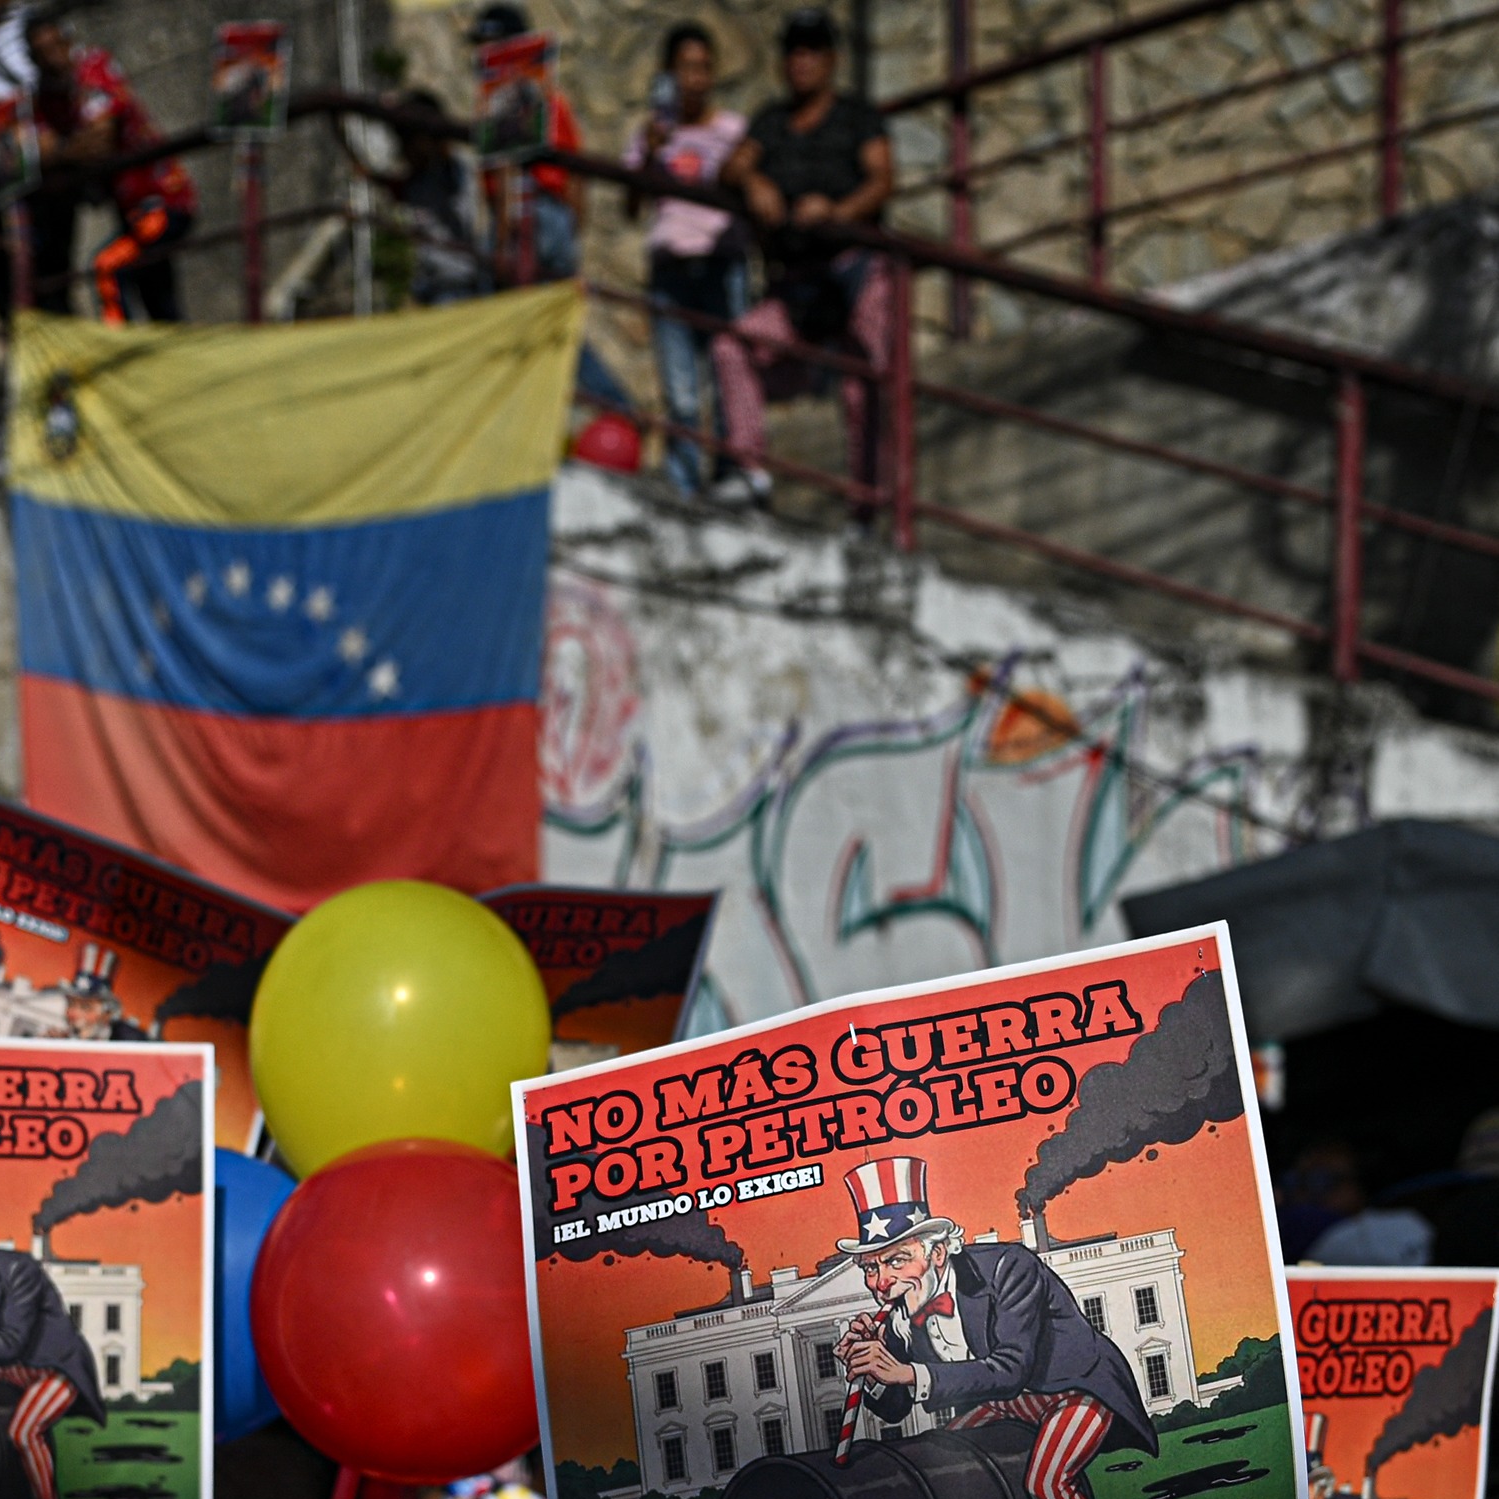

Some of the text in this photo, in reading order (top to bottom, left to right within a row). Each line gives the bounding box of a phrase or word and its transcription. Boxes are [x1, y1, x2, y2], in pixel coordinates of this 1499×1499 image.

[504, 902, 658, 938] UERRA
[541, 980, 1142, 1159] NO MÁS GUERRA
[548, 1054, 1077, 1213] POR PETRÓLEO
[553, 1164, 823, 1245] ¡EL MUNDO LO EXIGE!
[1298, 1299, 1452, 1347] GUERRA
[1297, 1346, 1414, 1398] RÓLEO
